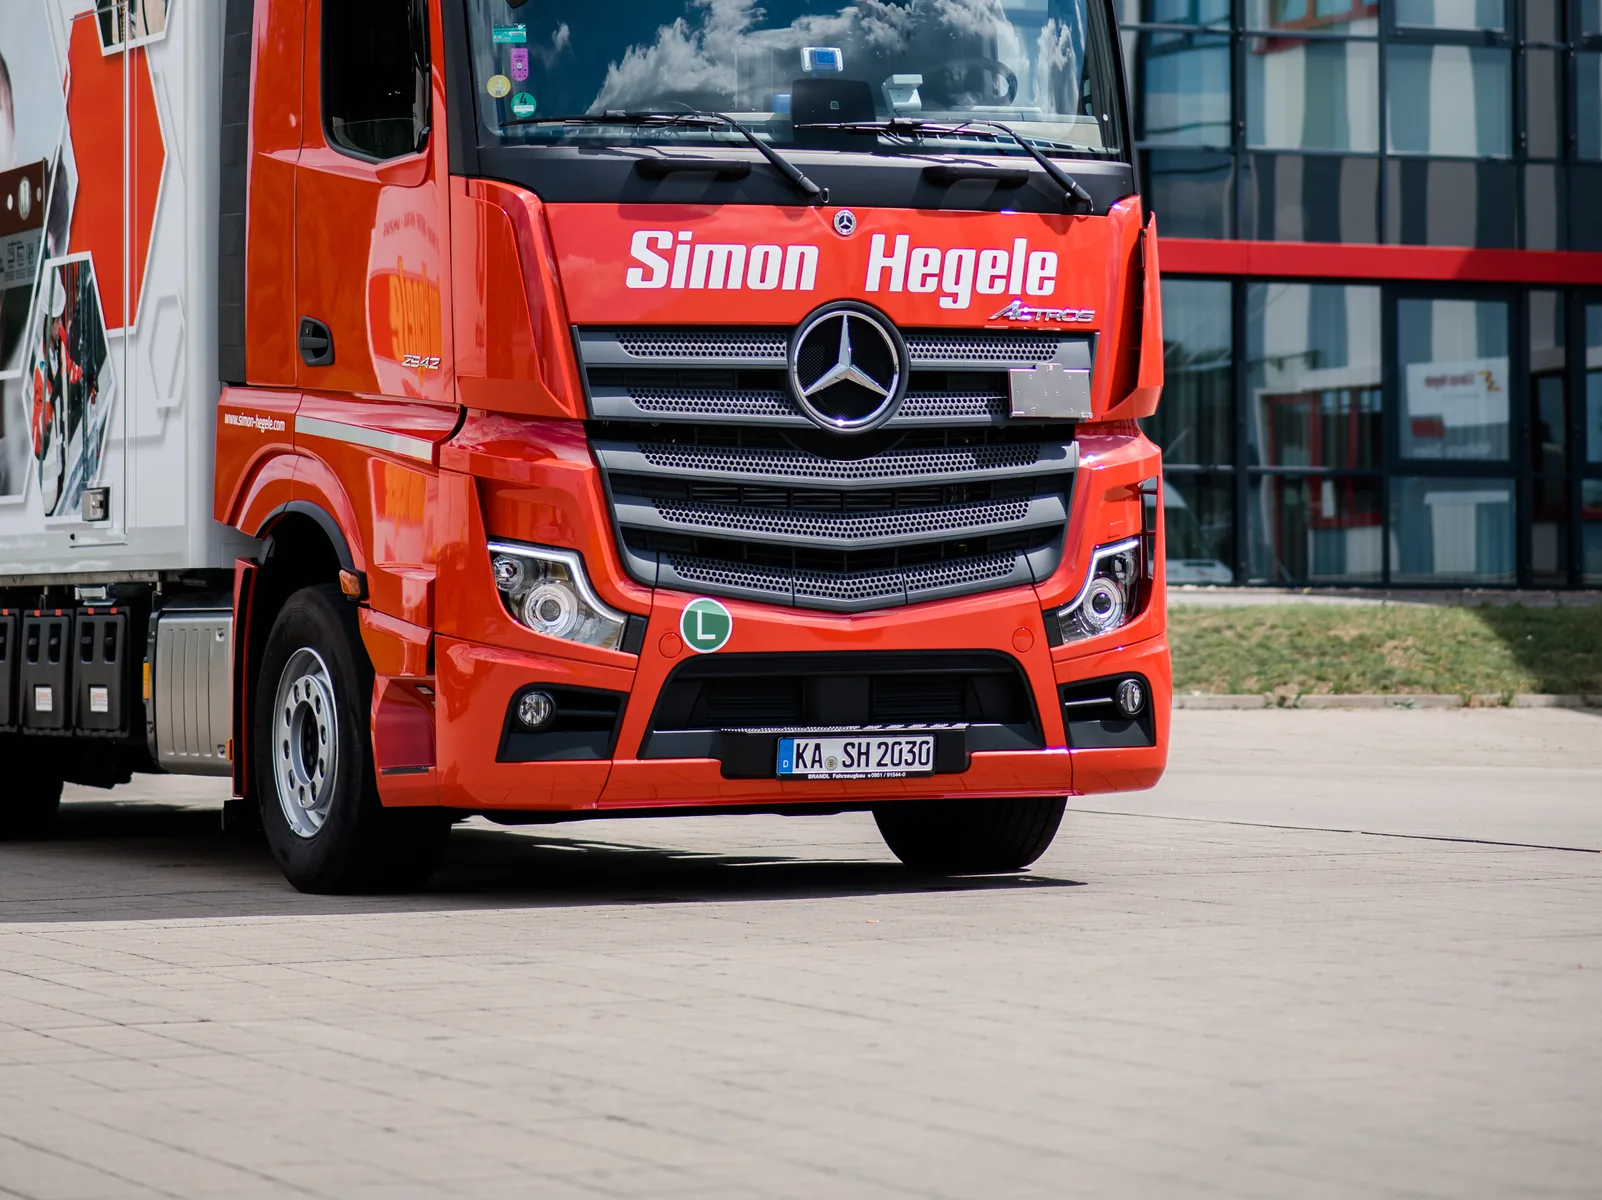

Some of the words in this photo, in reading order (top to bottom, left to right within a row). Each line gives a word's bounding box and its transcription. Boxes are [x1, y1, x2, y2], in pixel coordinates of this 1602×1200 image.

[520, 93, 528, 105] 4
[626, 230, 819, 291] Simon
[865, 234, 1058, 309] Hegele
[401, 354, 440, 370] 2542
[224, 411, 286, 433] www.simon-hegele.com
[697, 609, 716, 639] L
[782, 760, 789, 768] D
[795, 743, 823, 769] KA
[842, 742, 871, 768] SH
[876, 740, 931, 767] 2030
[832, 772, 866, 780] Fahrzeugbau
